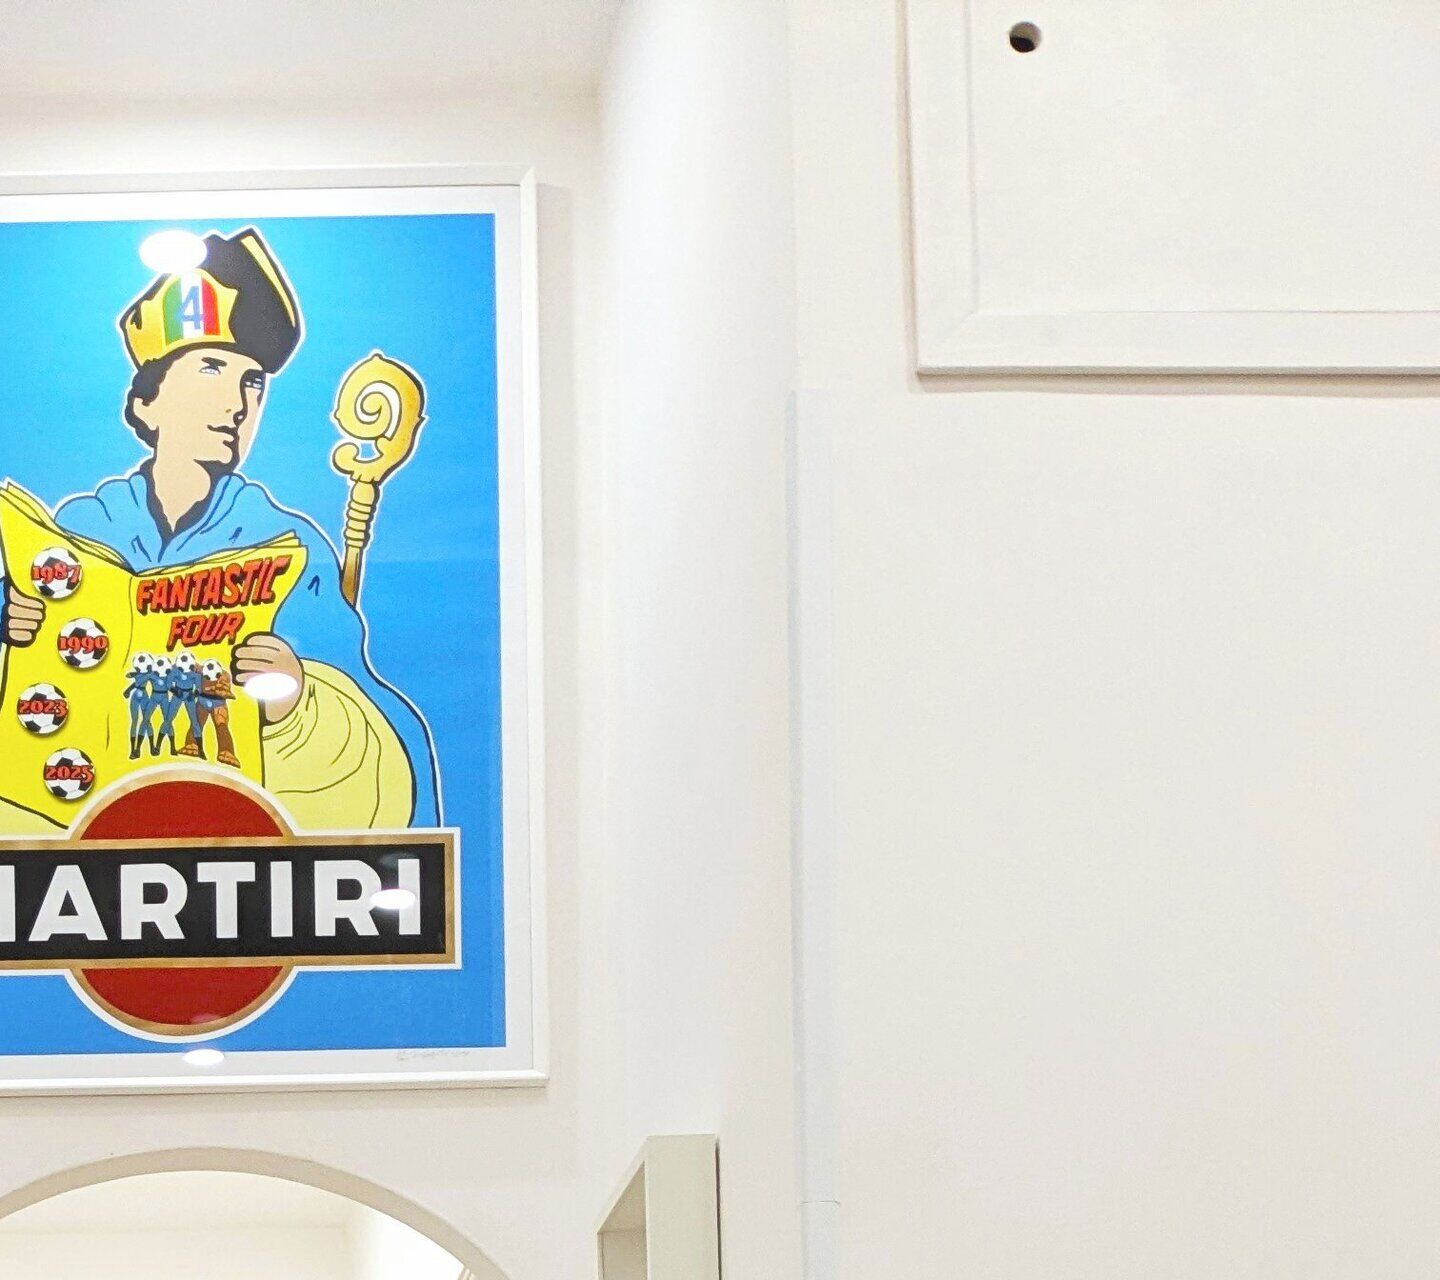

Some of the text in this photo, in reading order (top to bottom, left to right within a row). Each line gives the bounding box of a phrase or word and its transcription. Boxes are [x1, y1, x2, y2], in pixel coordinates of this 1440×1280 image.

[176, 285, 205, 330] 4
[31, 561, 83, 585] 1987
[136, 554, 293, 616] FANTASTIC
[166, 611, 245, 652] FOUR
[57, 634, 109, 655] 1990
[18, 698, 68, 719] 2023
[44, 763, 95, 785] 2025
